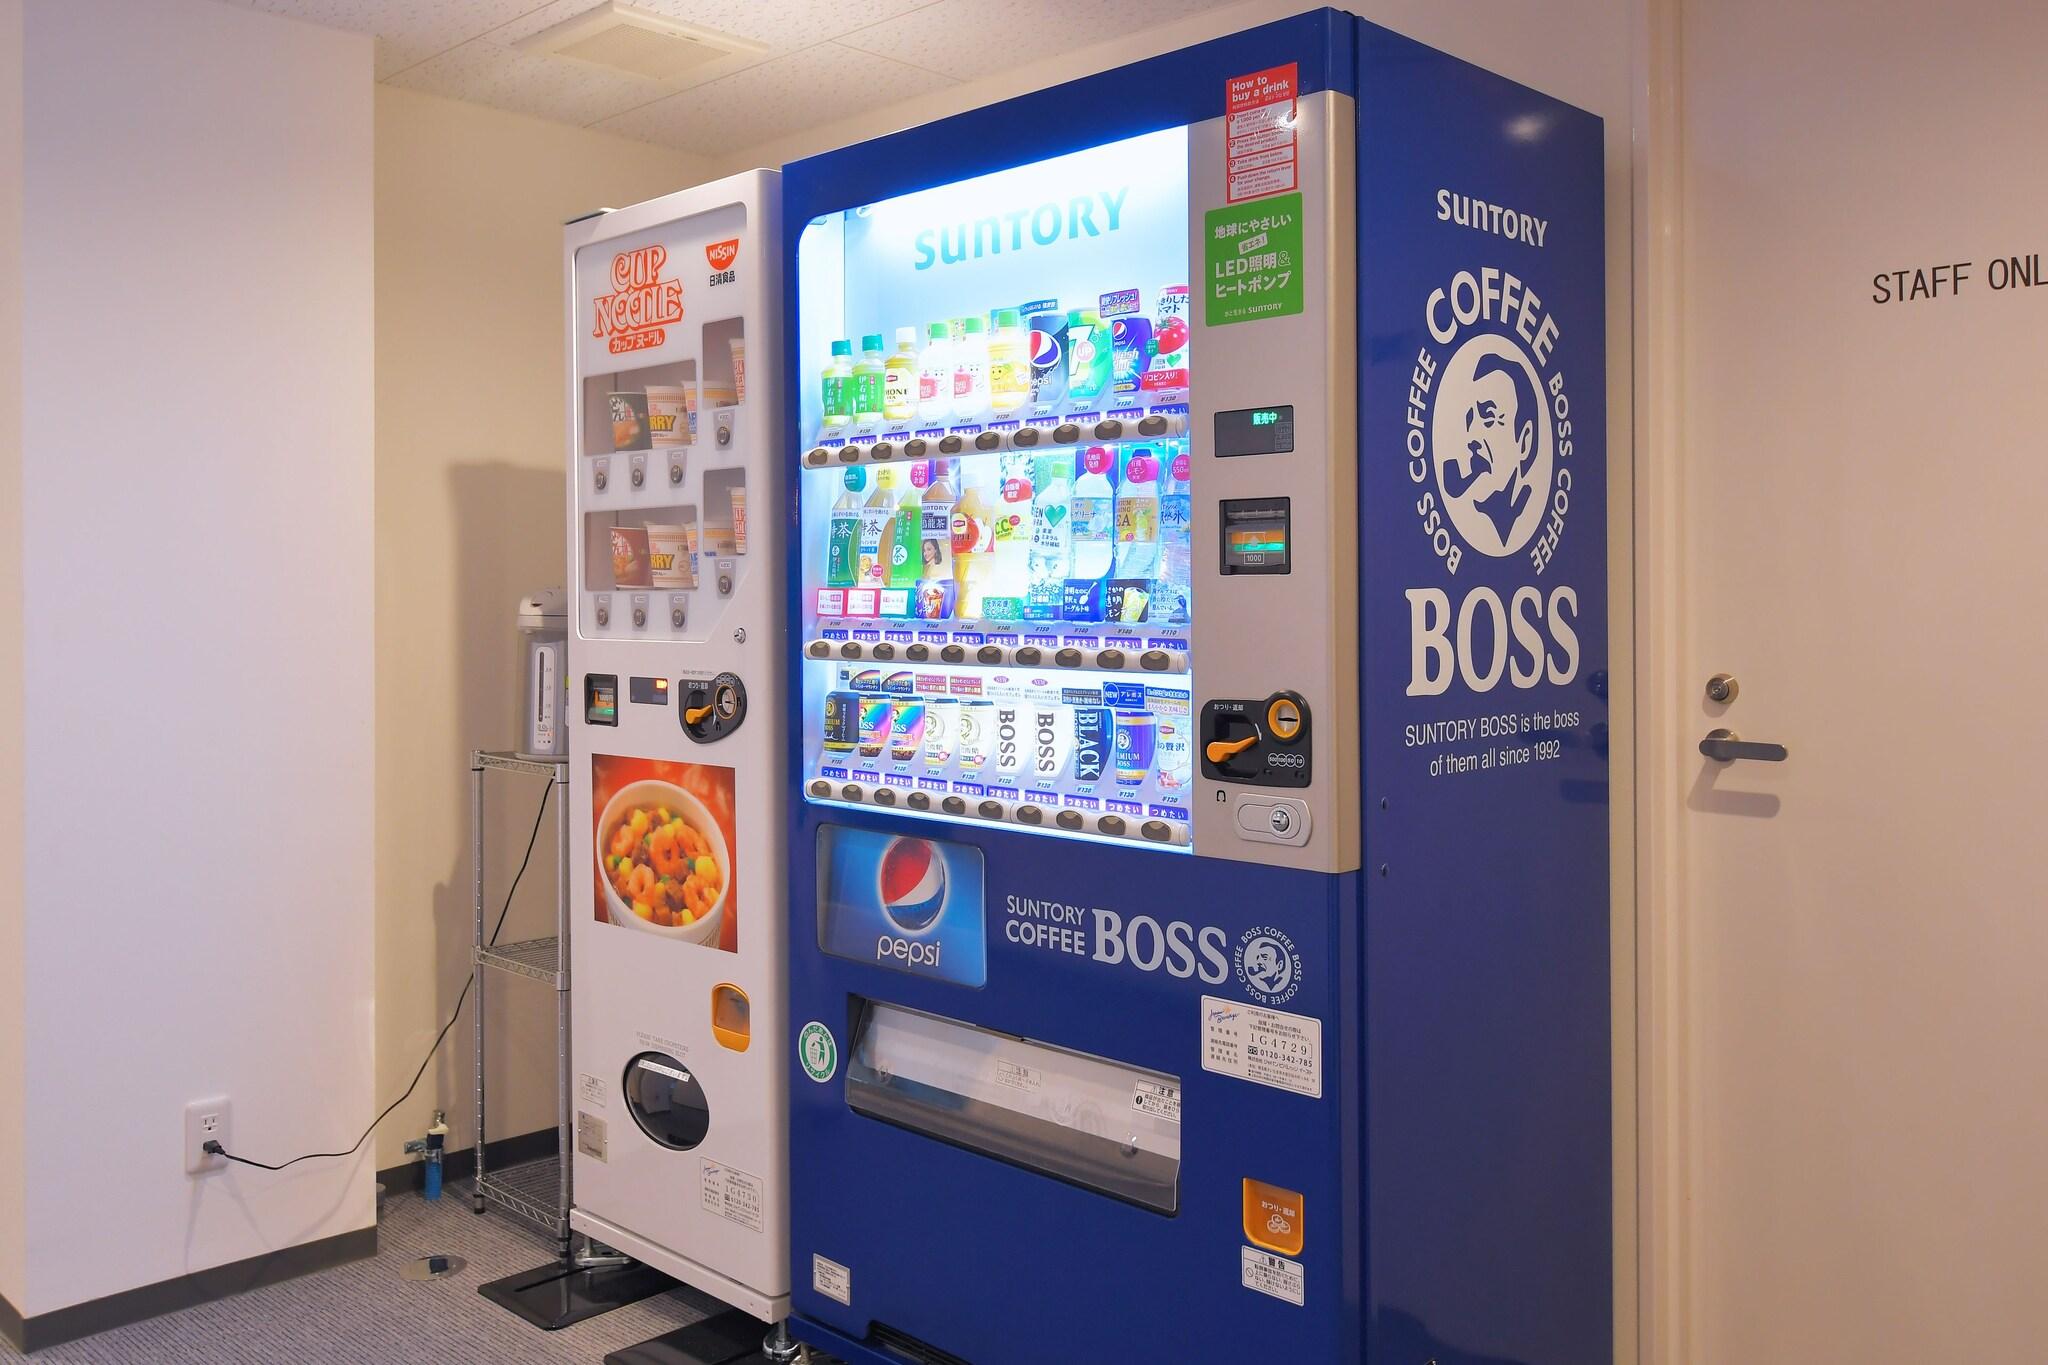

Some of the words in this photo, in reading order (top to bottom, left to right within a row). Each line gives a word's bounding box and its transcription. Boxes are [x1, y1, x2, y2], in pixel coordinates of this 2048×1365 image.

[1232, 80, 1253, 92] How
[1257, 76, 1267, 86] to
[1232, 91, 1250, 102] buy
[1263, 80, 1288, 95] drink
[914, 187, 1129, 271] SUNTORY
[1214, 214, 1292, 239] 地球にやさしい
[1436, 188, 1548, 248] SUNTORY
[709, 244, 736, 262] NISSIN
[610, 244, 666, 293] CUP
[709, 270, 736, 287] 日清食品
[1872, 262, 1972, 304] STAFF
[1988, 254, 2048, 290] ONL
[1215, 270, 1292, 298] ヒートポンプ
[592, 278, 684, 338] NOODLE
[1248, 302, 1283, 314] SUNTORY
[1426, 266, 1560, 368] COFFEE
[612, 329, 663, 353] カップヌードル
[1253, 412, 1278, 426] 販売中
[1406, 348, 1437, 484] COFFEE
[1548, 372, 1573, 456] BOSS
[1416, 492, 1463, 576] BOSS
[1530, 468, 1572, 576] COFFEE
[1246, 554, 1262, 562] 1000
[1405, 586, 1580, 696] BOSS
[1000, 710, 1016, 767] BOSS
[1405, 718, 1476, 747] SUNTORY
[1480, 714, 1517, 738] BOSS
[1520, 713, 1530, 733] is
[1534, 711, 1551, 731] the
[1554, 709, 1580, 728] boss
[1038, 712, 1055, 772] BOSS
[1078, 709, 1100, 781] BLACK
[1430, 754, 1442, 776] of
[1447, 751, 1478, 774] them
[1482, 748, 1495, 768] all
[1499, 746, 1530, 766] since
[1534, 740, 1560, 761] 1992
[823, 770, 846, 778] つめたい
[854, 773, 878, 782] つめたい
[887, 777, 911, 786] つめたい
[920, 781, 945, 790] つめたい
[955, 785, 981, 794] つめたい
[989, 789, 1016, 798] つめたい
[1027, 794, 1056, 803] つめたい
[1068, 799, 1096, 808] つめたい
[1109, 803, 1139, 813] つめたい
[1152, 809, 1184, 819] つめたい
[1006, 894, 1086, 926] SUNTORY
[1005, 920, 1086, 956] COFFEE
[1091, 908, 1229, 985] BOSS
[1241, 926, 1262, 944] BOSS
[1264, 926, 1294, 952] COFFEE
[876, 934, 942, 968] pepsi
[1234, 945, 1246, 983] COFFEE
[1292, 954, 1302, 982] BOSS
[1246, 984, 1267, 1004] BOSS
[1270, 983, 1298, 1005] COFFEE
[1250, 1033, 1307, 1055] 1G4729
[1260, 1049, 1312, 1068] 0120-342-785
[1158, 1086, 1174, 1098] 注意
[1268, 1257, 1285, 1270] 警告
